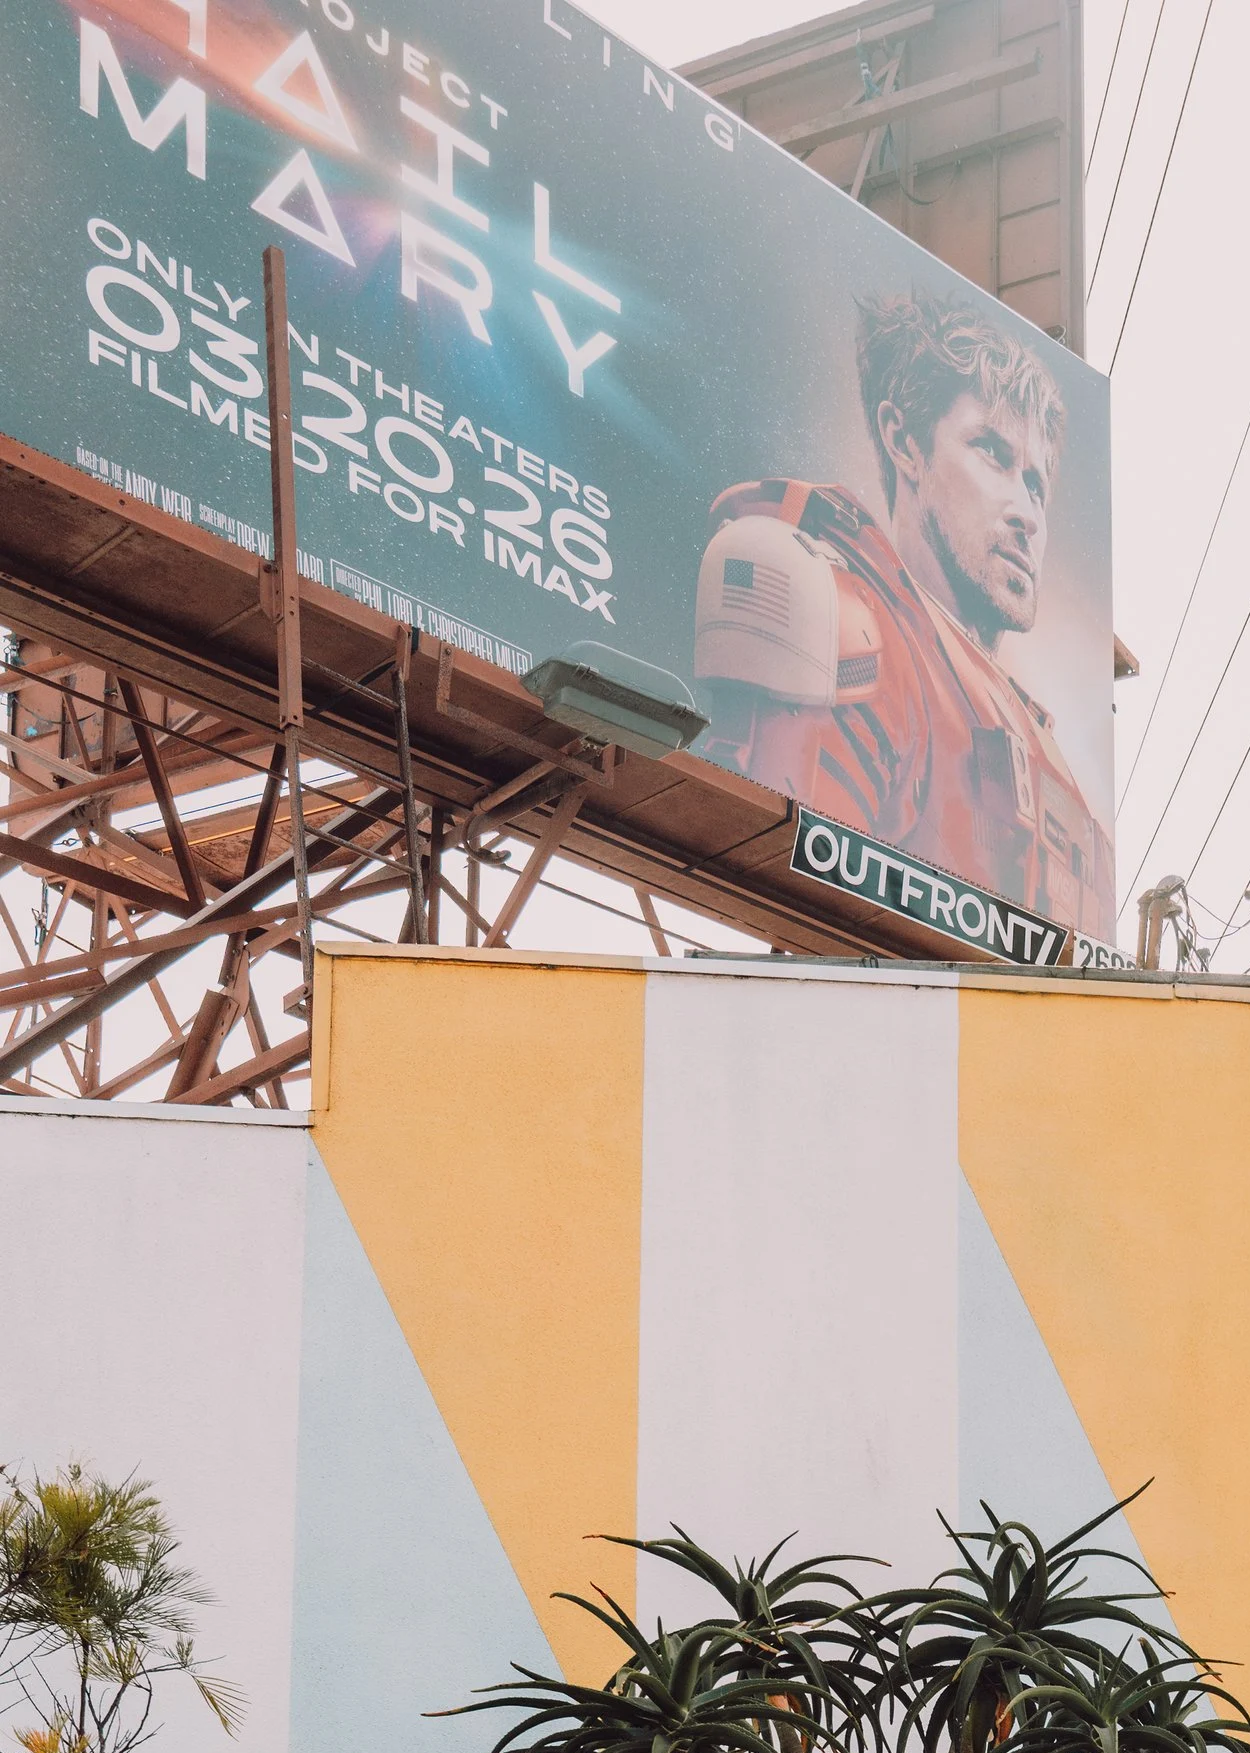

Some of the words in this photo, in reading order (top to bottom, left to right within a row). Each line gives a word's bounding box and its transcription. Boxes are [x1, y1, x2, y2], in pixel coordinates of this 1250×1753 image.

[79, 16, 618, 398] MARY
[85, 265, 614, 580] 0320.26
[87, 217, 252, 321] ONLY
[335, 347, 610, 521] THEATERS
[76, 446, 98, 471] BASED
[111, 461, 123, 483] THE
[88, 328, 328, 474] FILMED
[348, 467, 466, 548] FOR
[484, 530, 617, 625] IMAX
[125, 469, 157, 507] ANDY
[199, 503, 236, 535] SCREENPLAY
[428, 610, 493, 664] CHRISTOPHER
